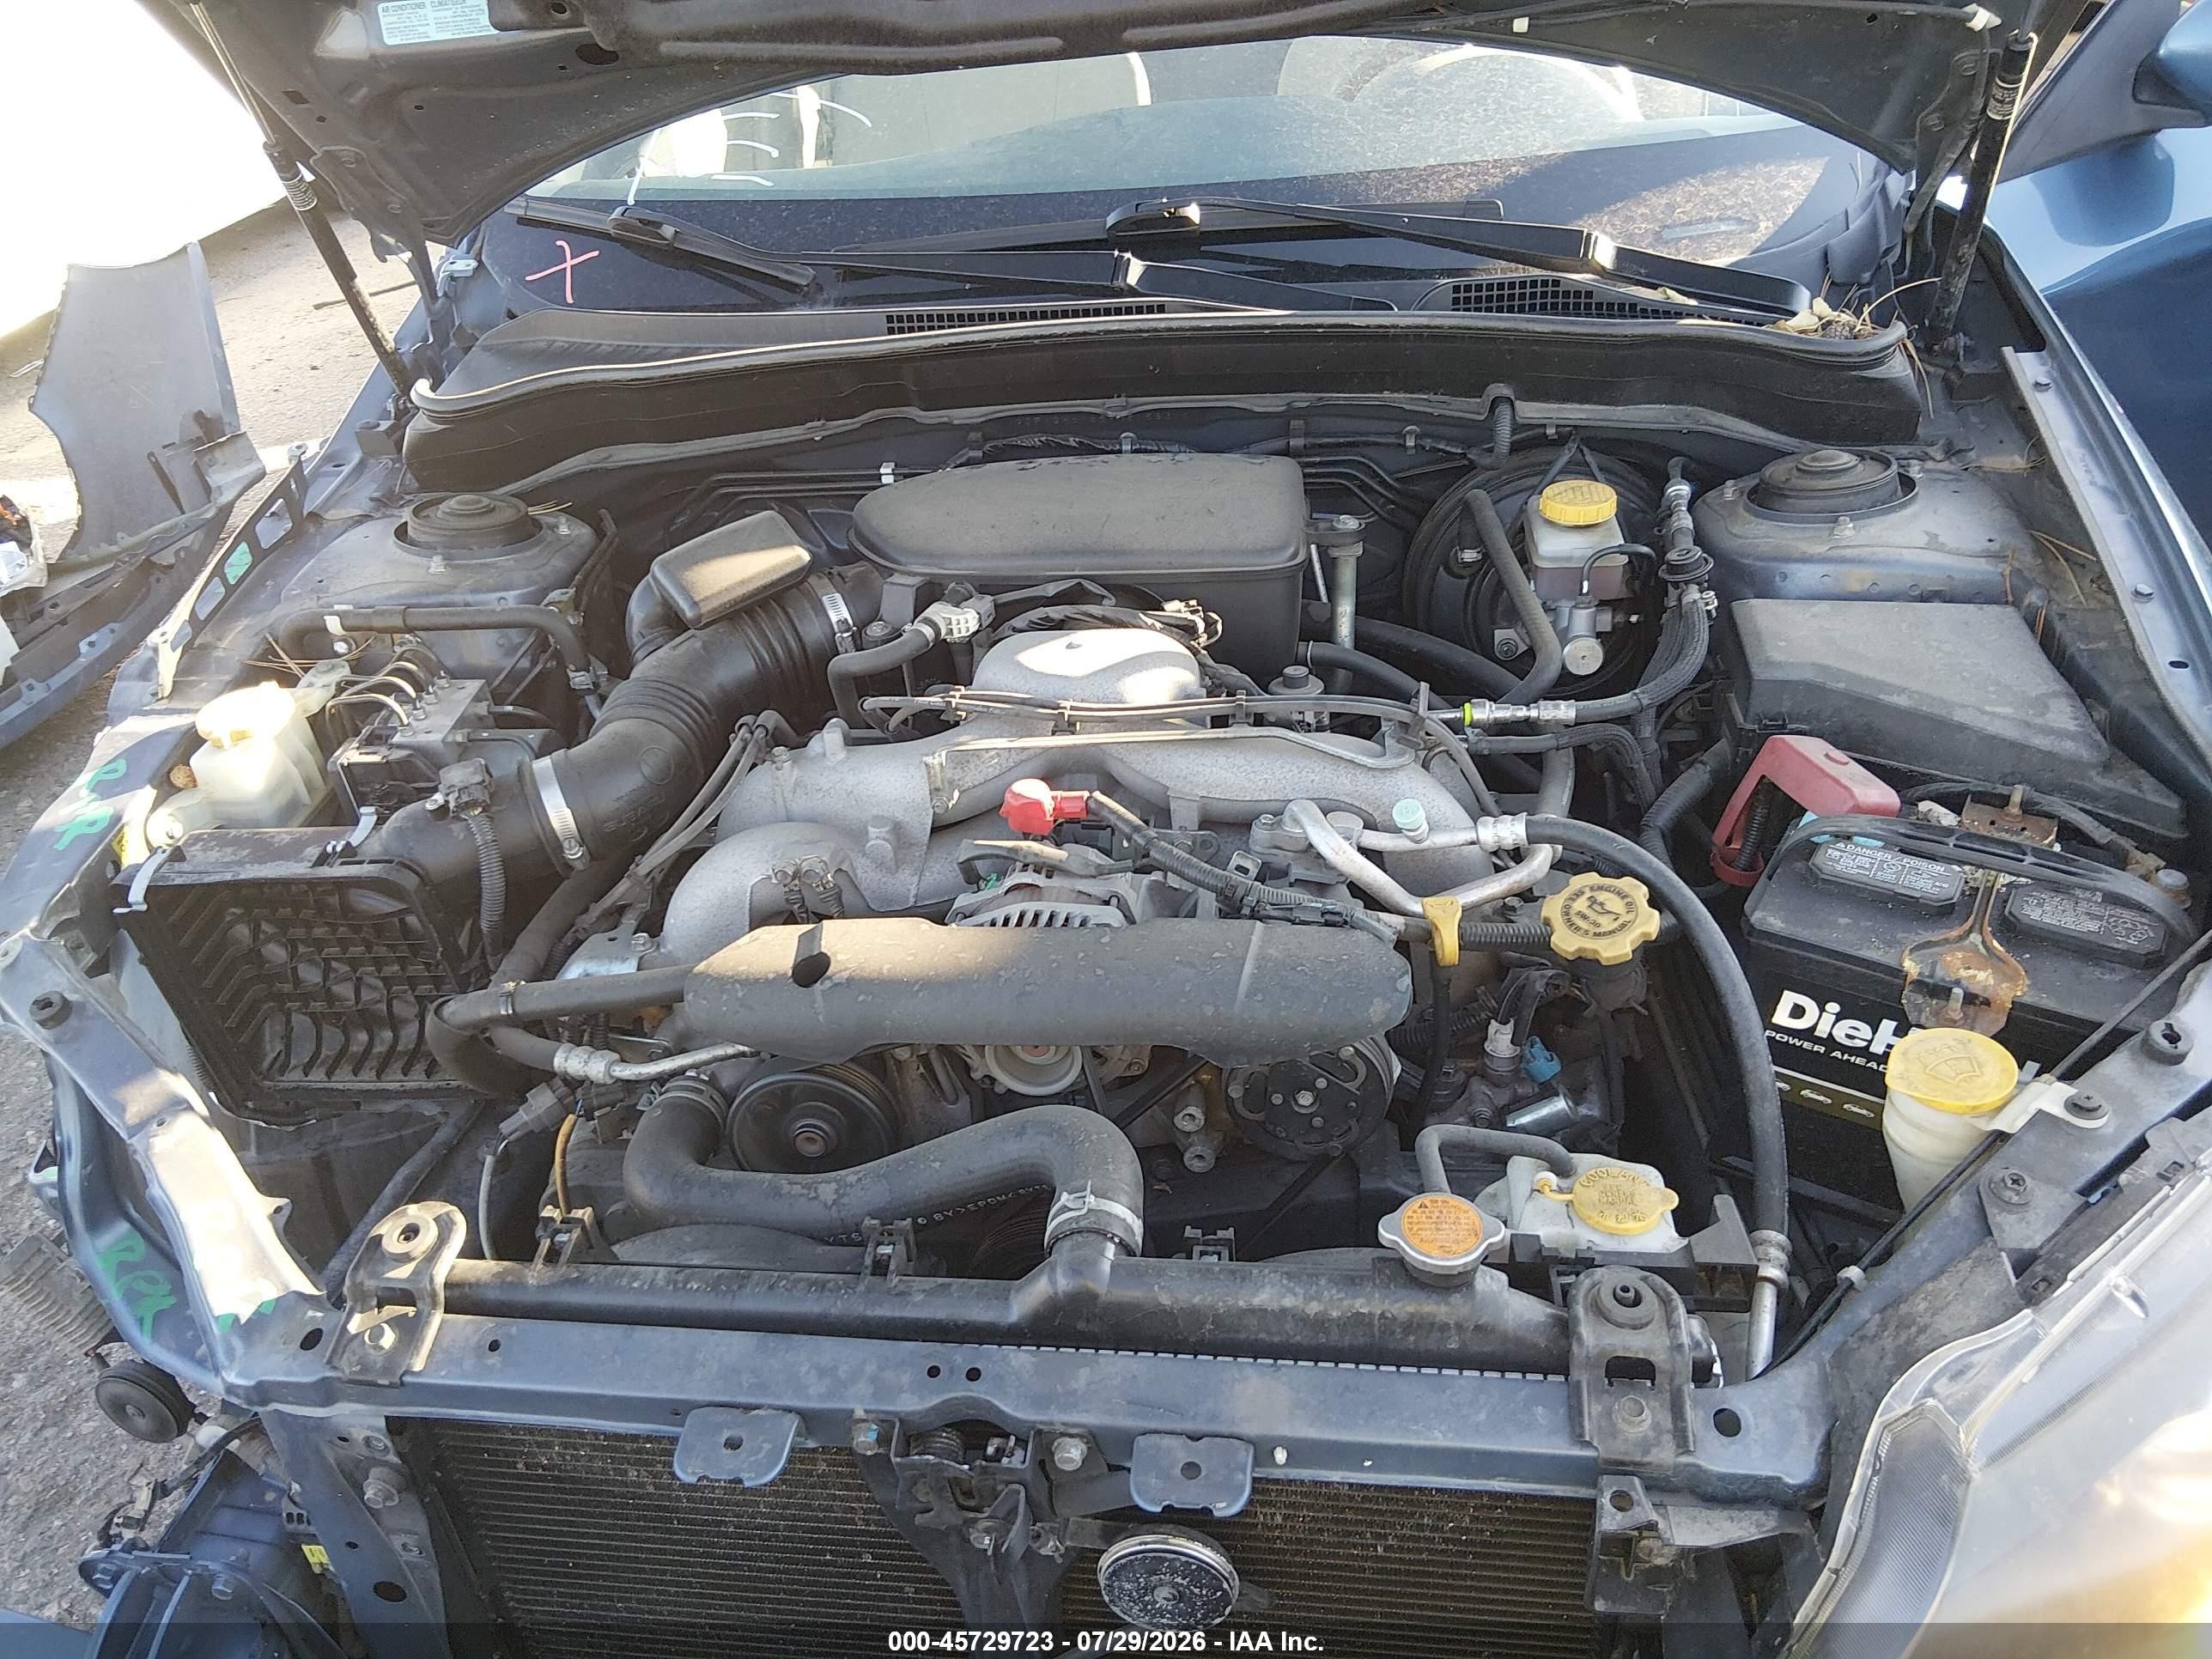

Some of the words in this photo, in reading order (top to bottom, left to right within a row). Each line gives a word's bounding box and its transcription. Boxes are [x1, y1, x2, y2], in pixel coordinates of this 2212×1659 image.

[1846, 844, 1891, 860] DANGER
[1902, 857, 1946, 872] POISON
[1589, 885, 1628, 900] ENGINE
[1625, 901, 1635, 915] OIL
[1593, 920, 1632, 938] MANUAL
[1764, 1030, 1826, 1054] POWER
